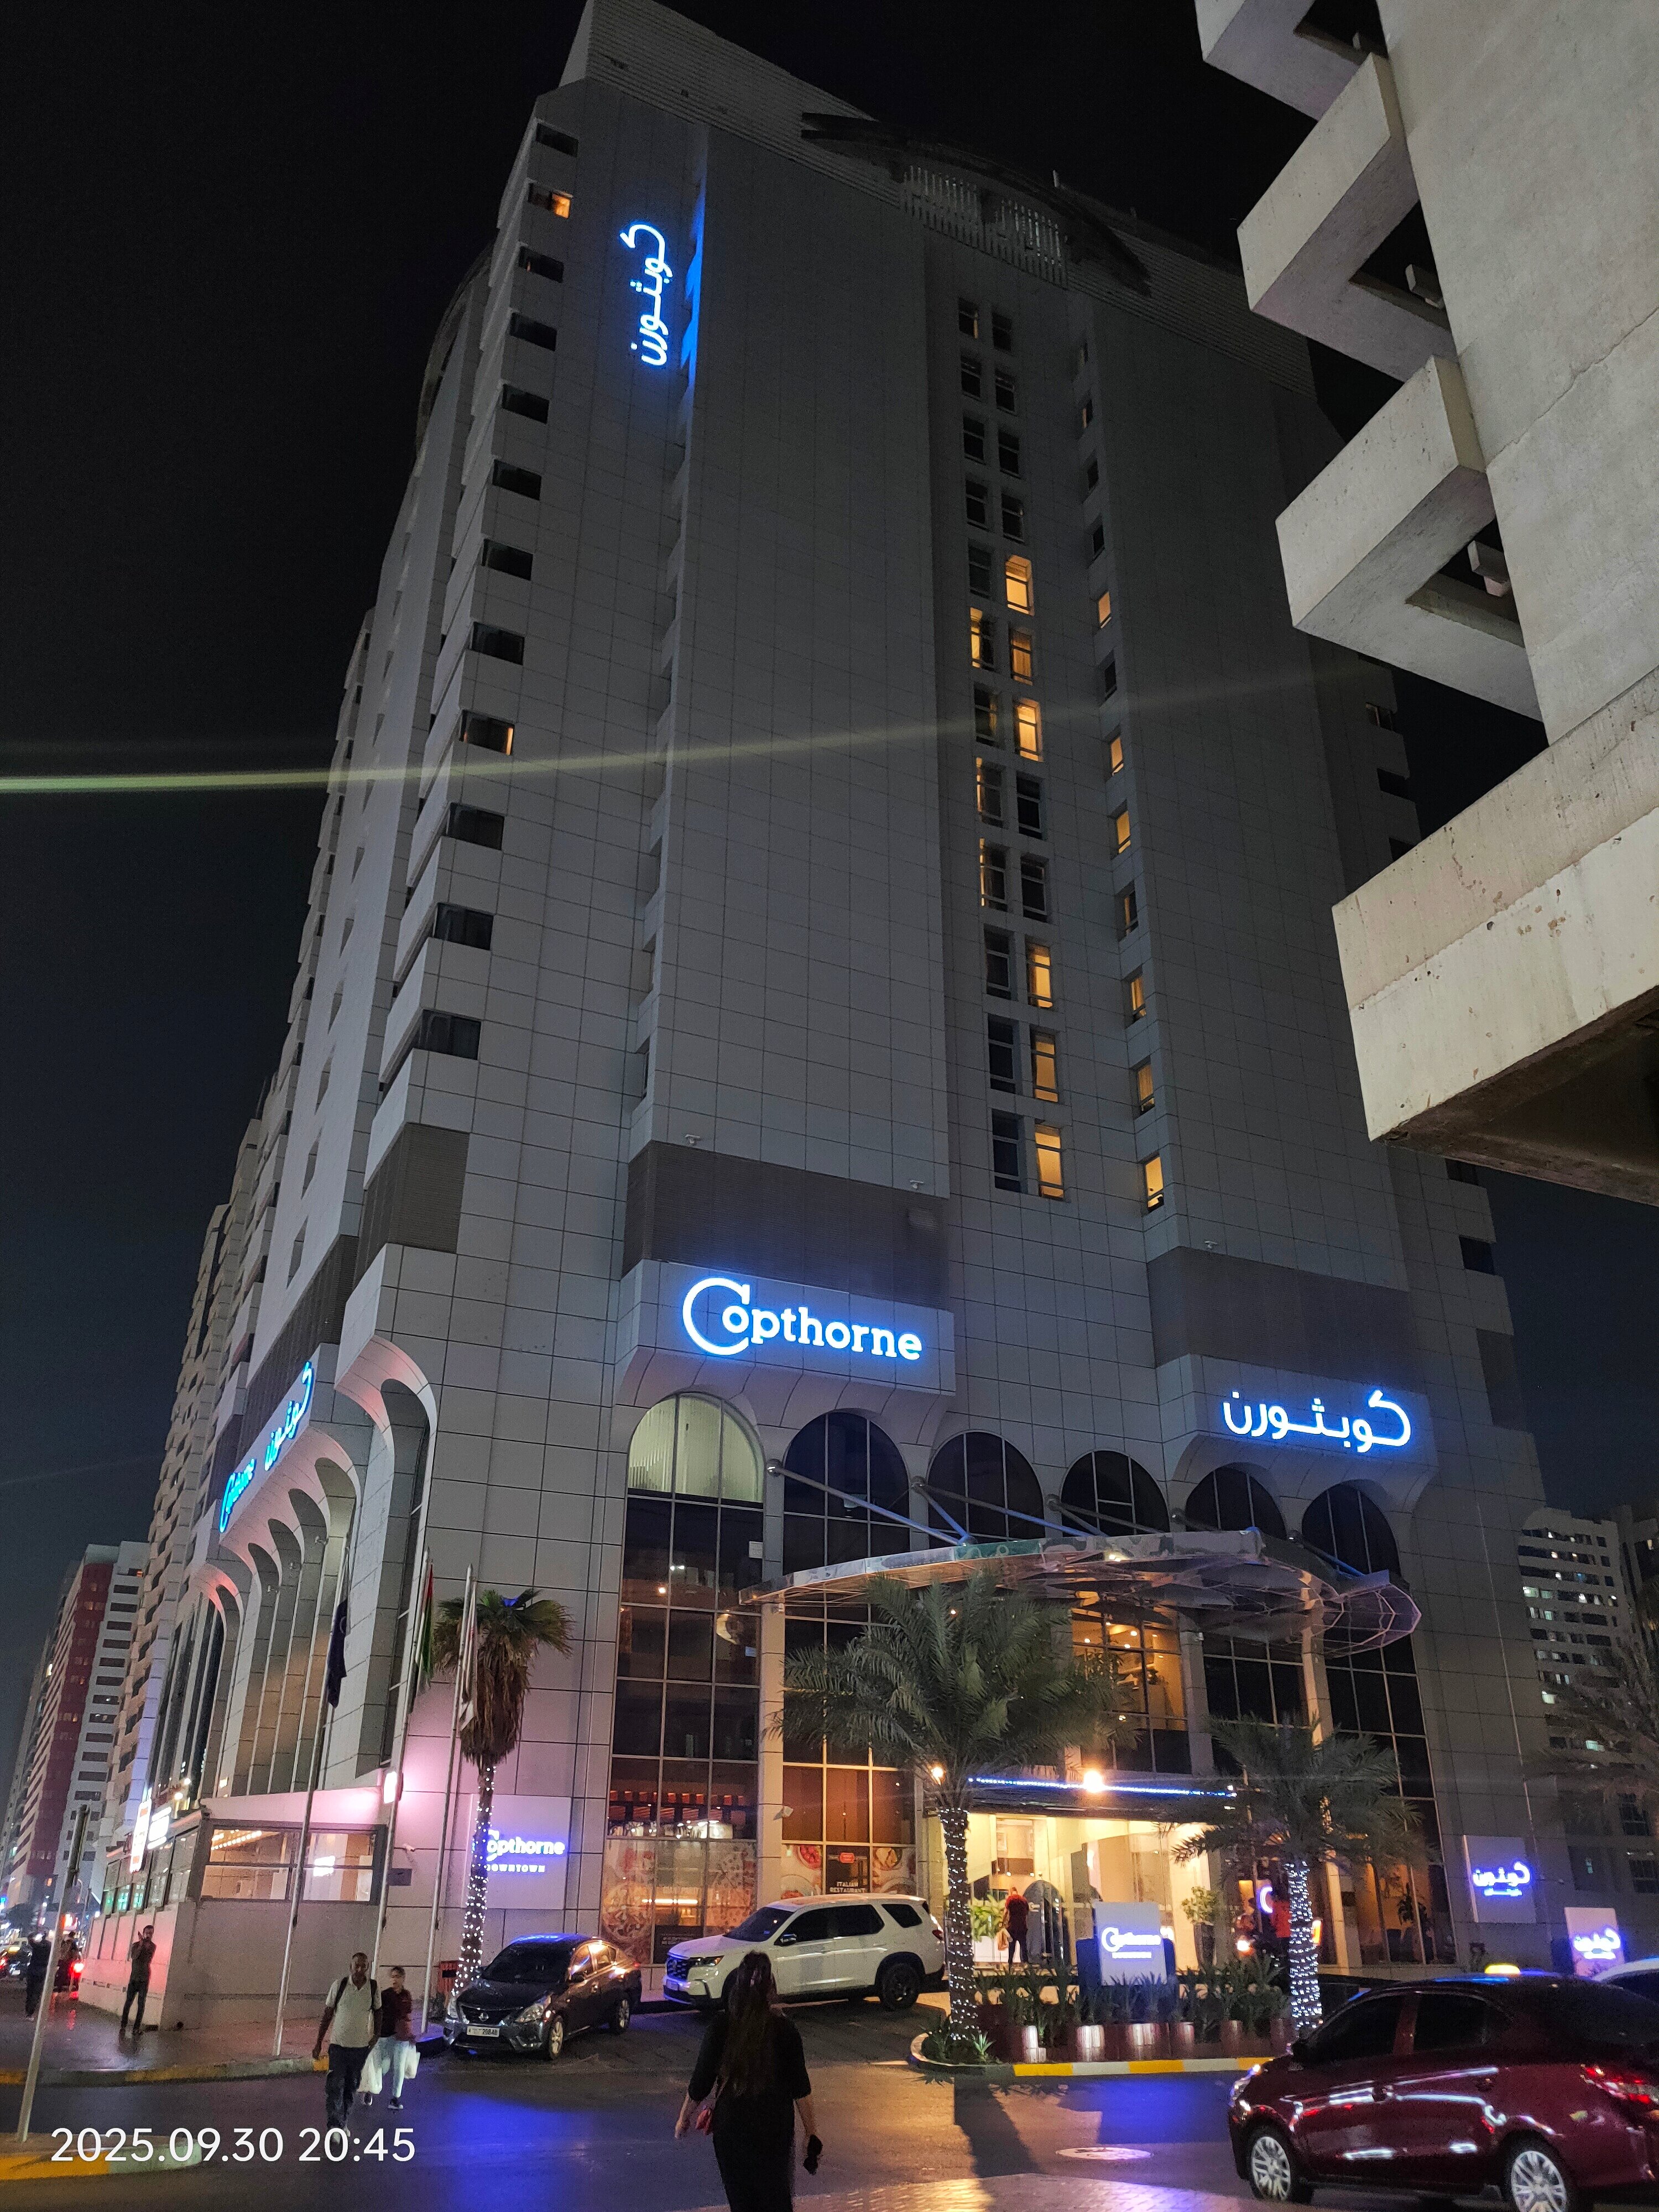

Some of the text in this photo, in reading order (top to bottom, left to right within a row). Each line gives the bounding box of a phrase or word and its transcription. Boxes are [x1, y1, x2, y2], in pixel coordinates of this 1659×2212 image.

[619, 223, 673, 366] كوبثورن
[682, 1277, 922, 1360] Copthorne
[1223, 1389, 1411, 1453] كوبثورن
